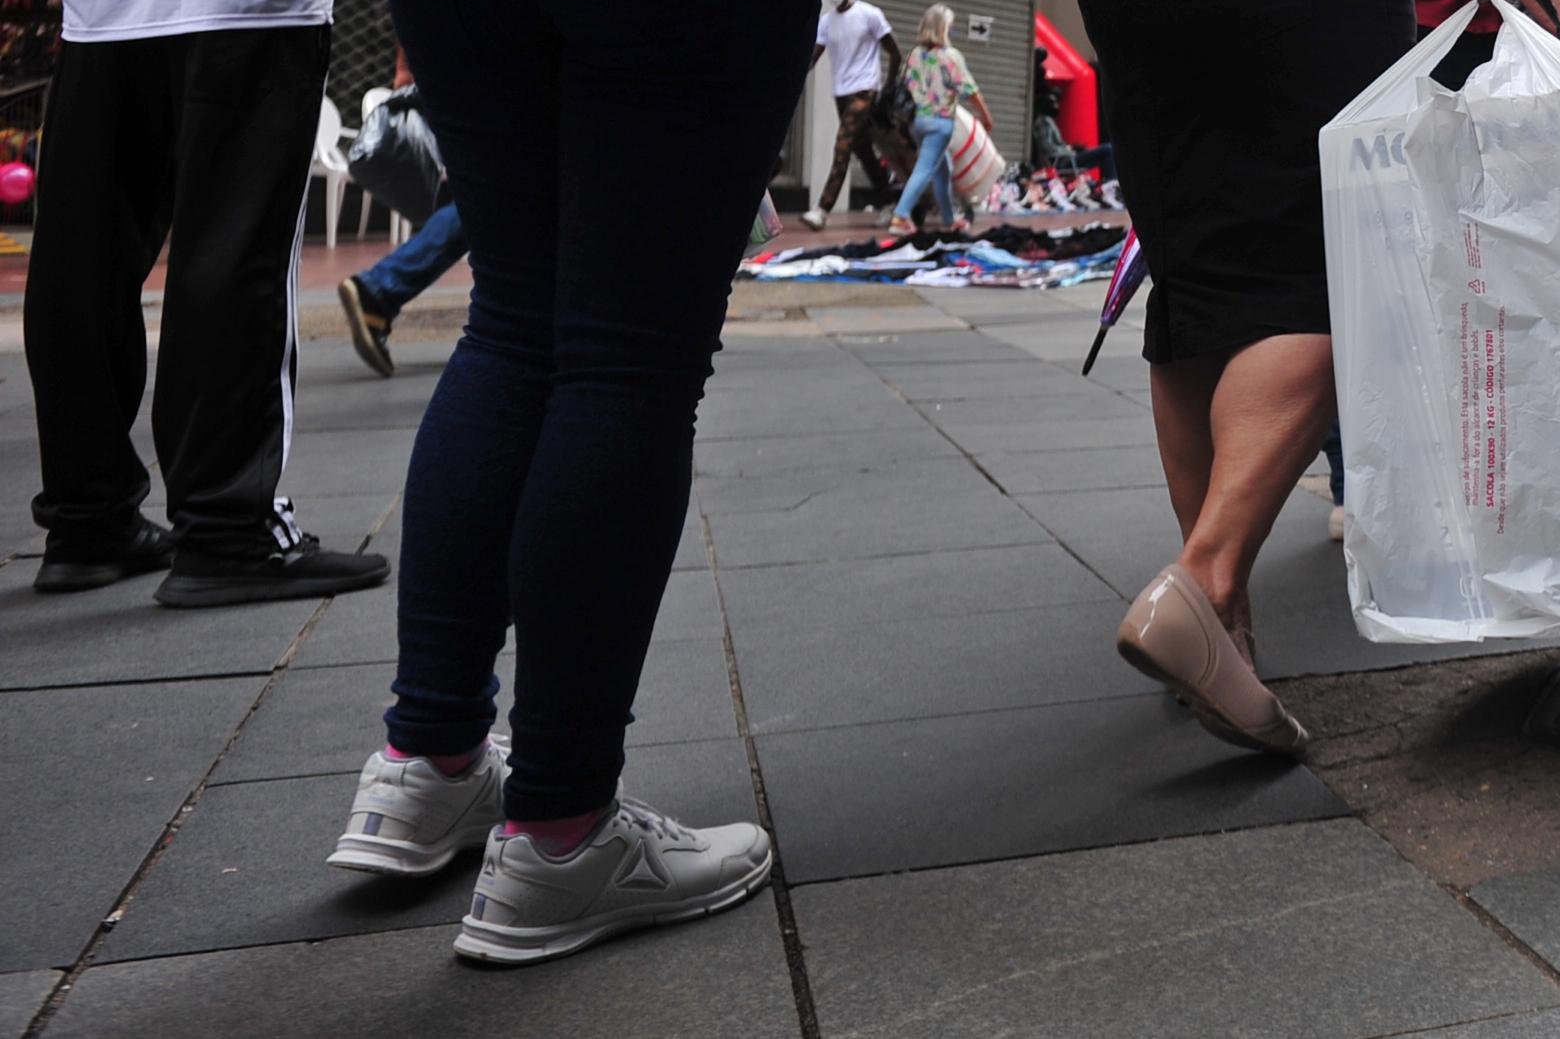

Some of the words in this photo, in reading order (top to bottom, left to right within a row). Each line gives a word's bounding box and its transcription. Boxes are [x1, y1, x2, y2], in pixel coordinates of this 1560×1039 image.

[1463, 341, 1468, 353] um
[1486, 330, 1494, 362] 1767801
[1498, 355, 1506, 393] perfurantes
[1485, 365, 1494, 398] CÓDIGO
[1473, 392, 1479, 400] de
[1487, 406, 1494, 418] KG
[1488, 420, 1495, 429] 12
[1473, 431, 1480, 441] do
[1463, 472, 1469, 480] de
